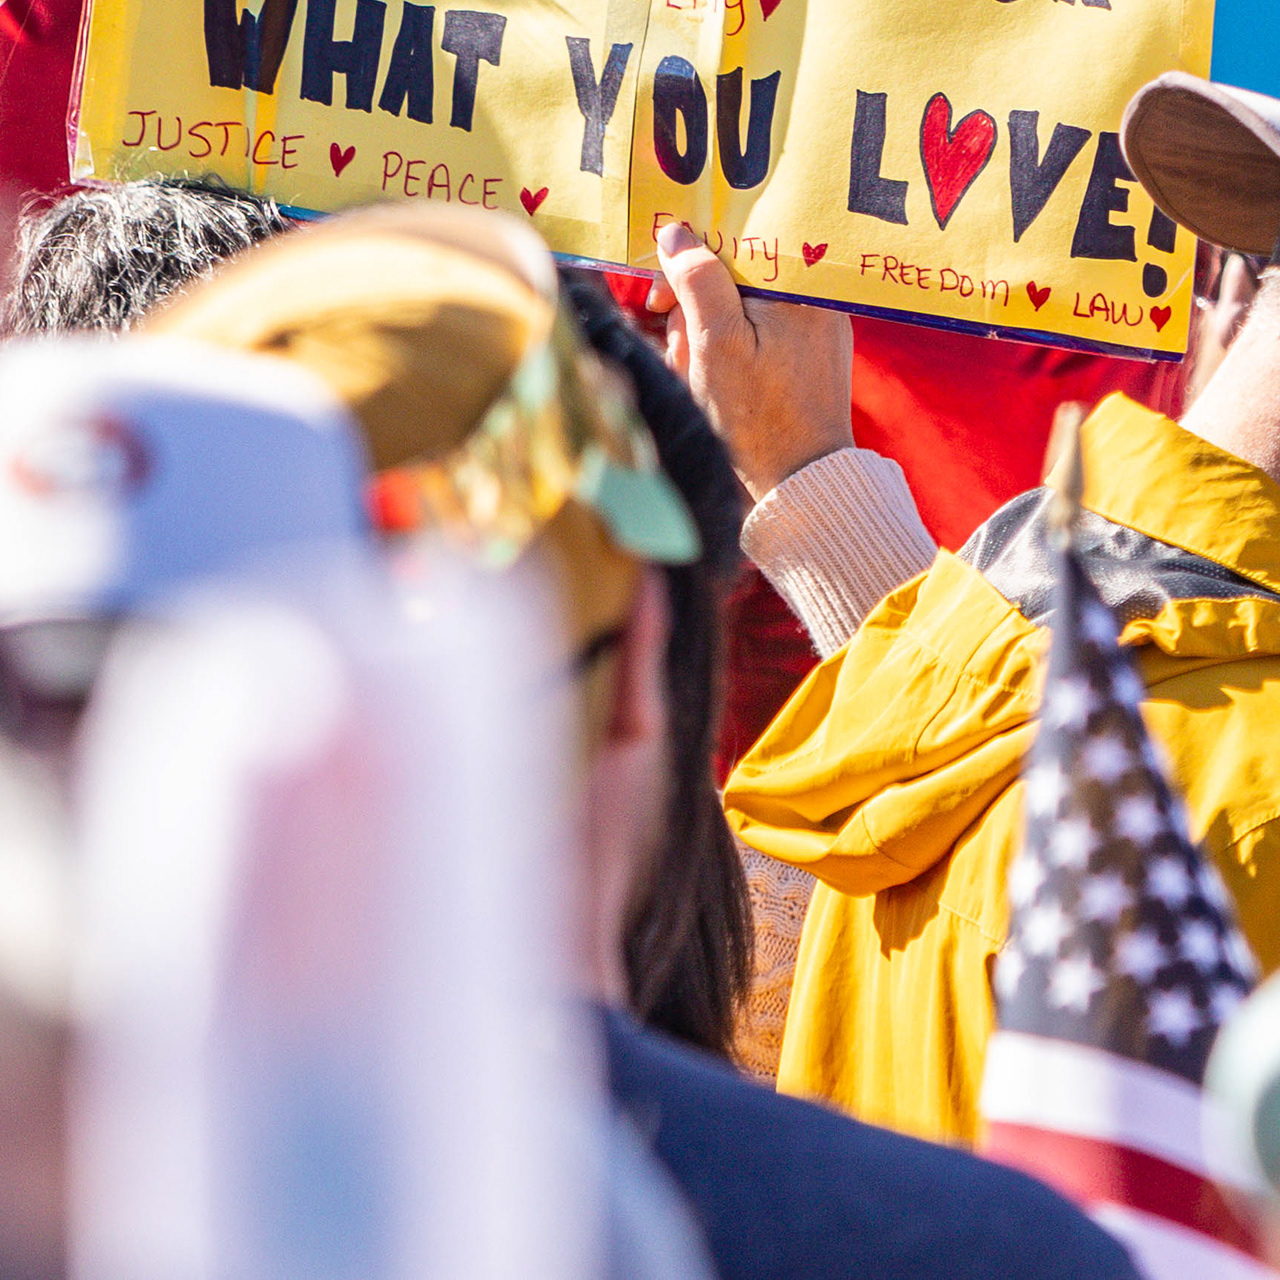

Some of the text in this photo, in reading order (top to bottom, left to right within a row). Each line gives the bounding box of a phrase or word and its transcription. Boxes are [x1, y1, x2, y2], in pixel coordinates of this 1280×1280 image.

[565, 35, 782, 190] YOU
[122, 110, 305, 170] JUSTICE
[382, 151, 504, 210] PEACE
[860, 253, 1010, 301] FREEDOM
[1073, 291, 1144, 327] LAW
